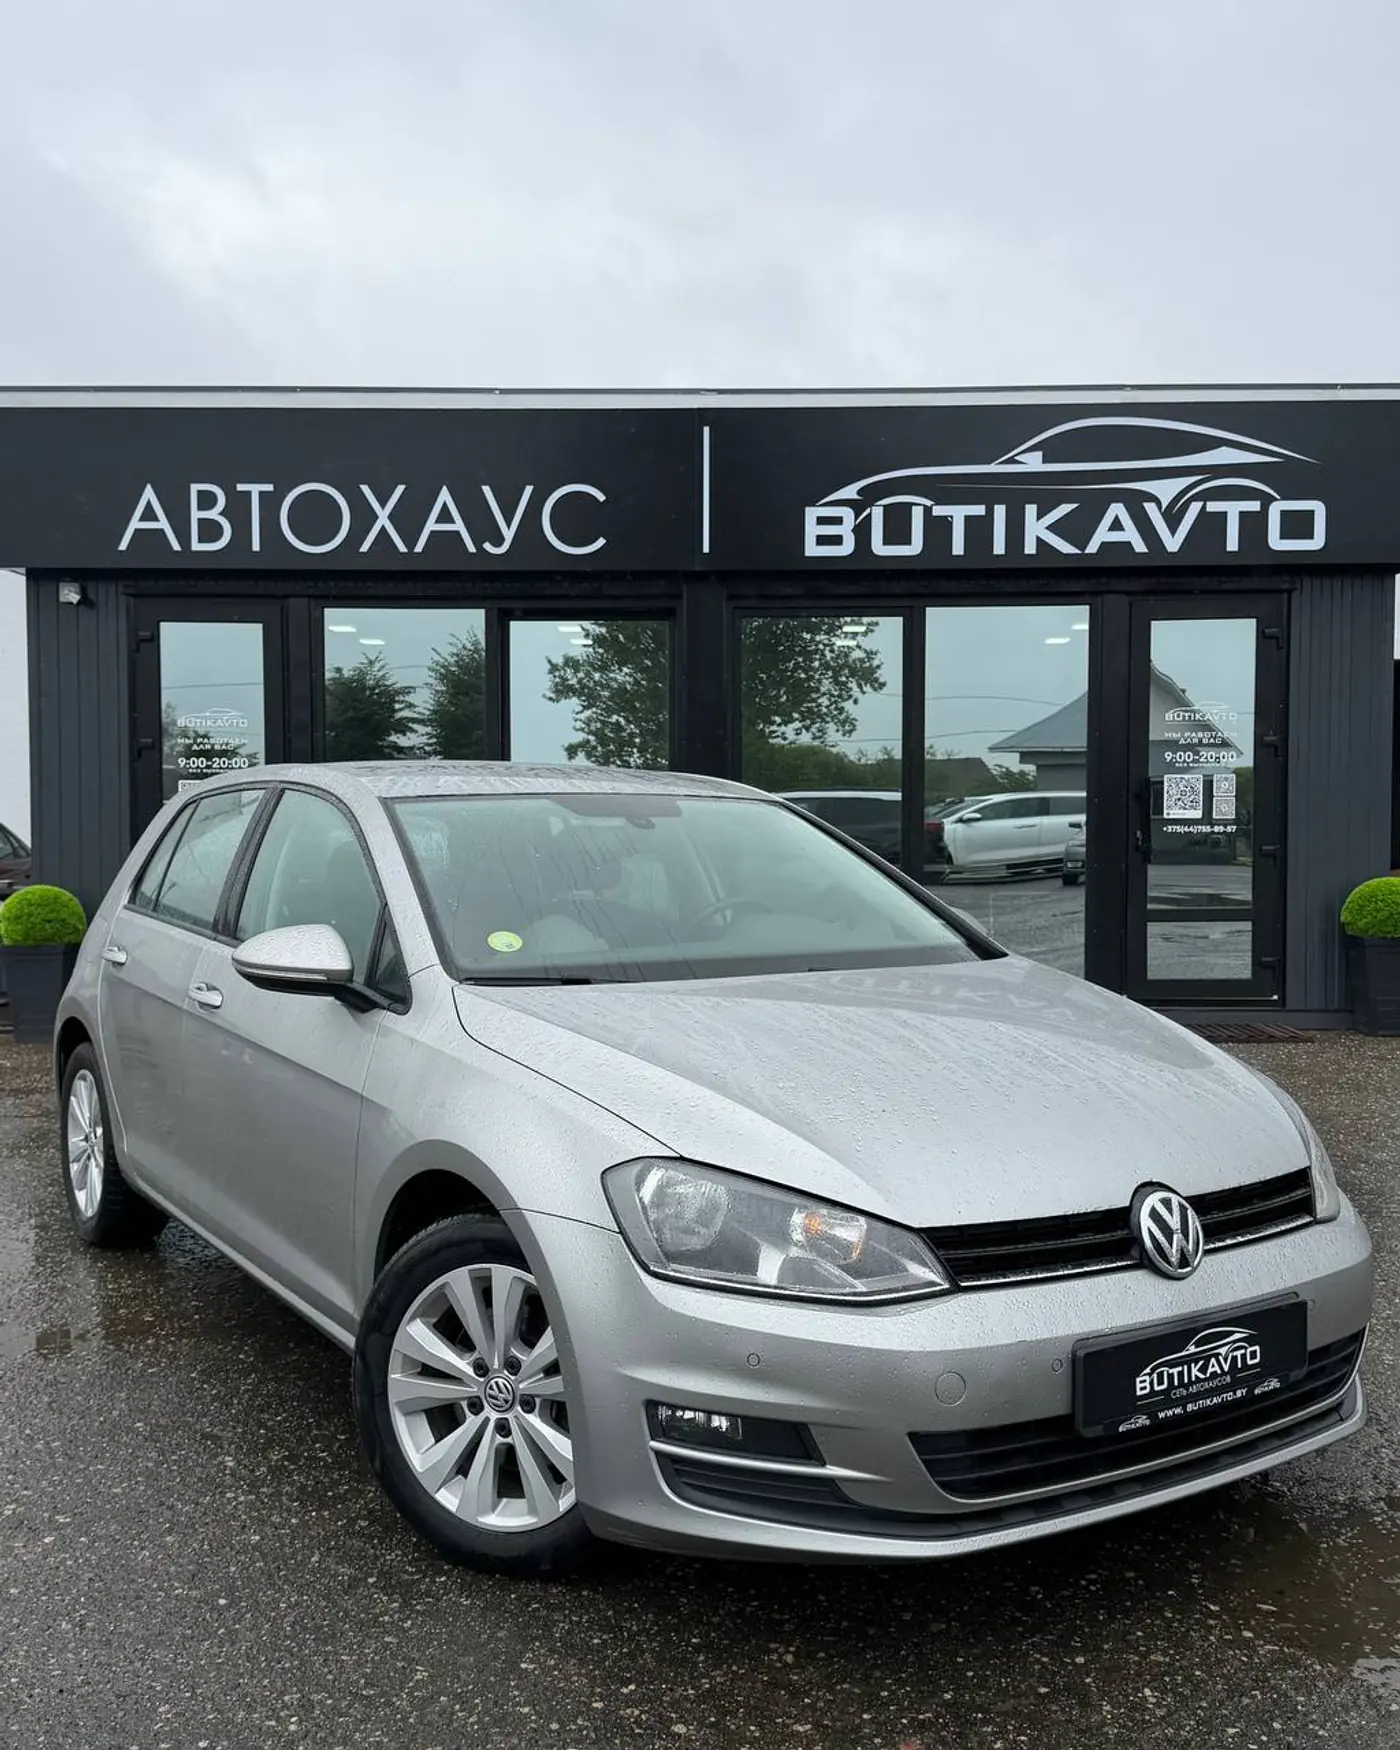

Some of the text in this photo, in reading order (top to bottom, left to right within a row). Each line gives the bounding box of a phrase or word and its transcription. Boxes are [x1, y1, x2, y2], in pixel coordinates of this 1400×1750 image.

[118, 482, 608, 556] АВТОХАУС
[804, 498, 1326, 557] BUTIKAVTO
[1164, 711, 1238, 721] BUTIKAVTO
[177, 757, 249, 769] 9:00-20:00
[1164, 751, 1237, 763] 9:00-20:00
[1135, 1344, 1261, 1397] BUTIKAVTO
[1170, 1387, 1188, 1399] СЕТЬ
